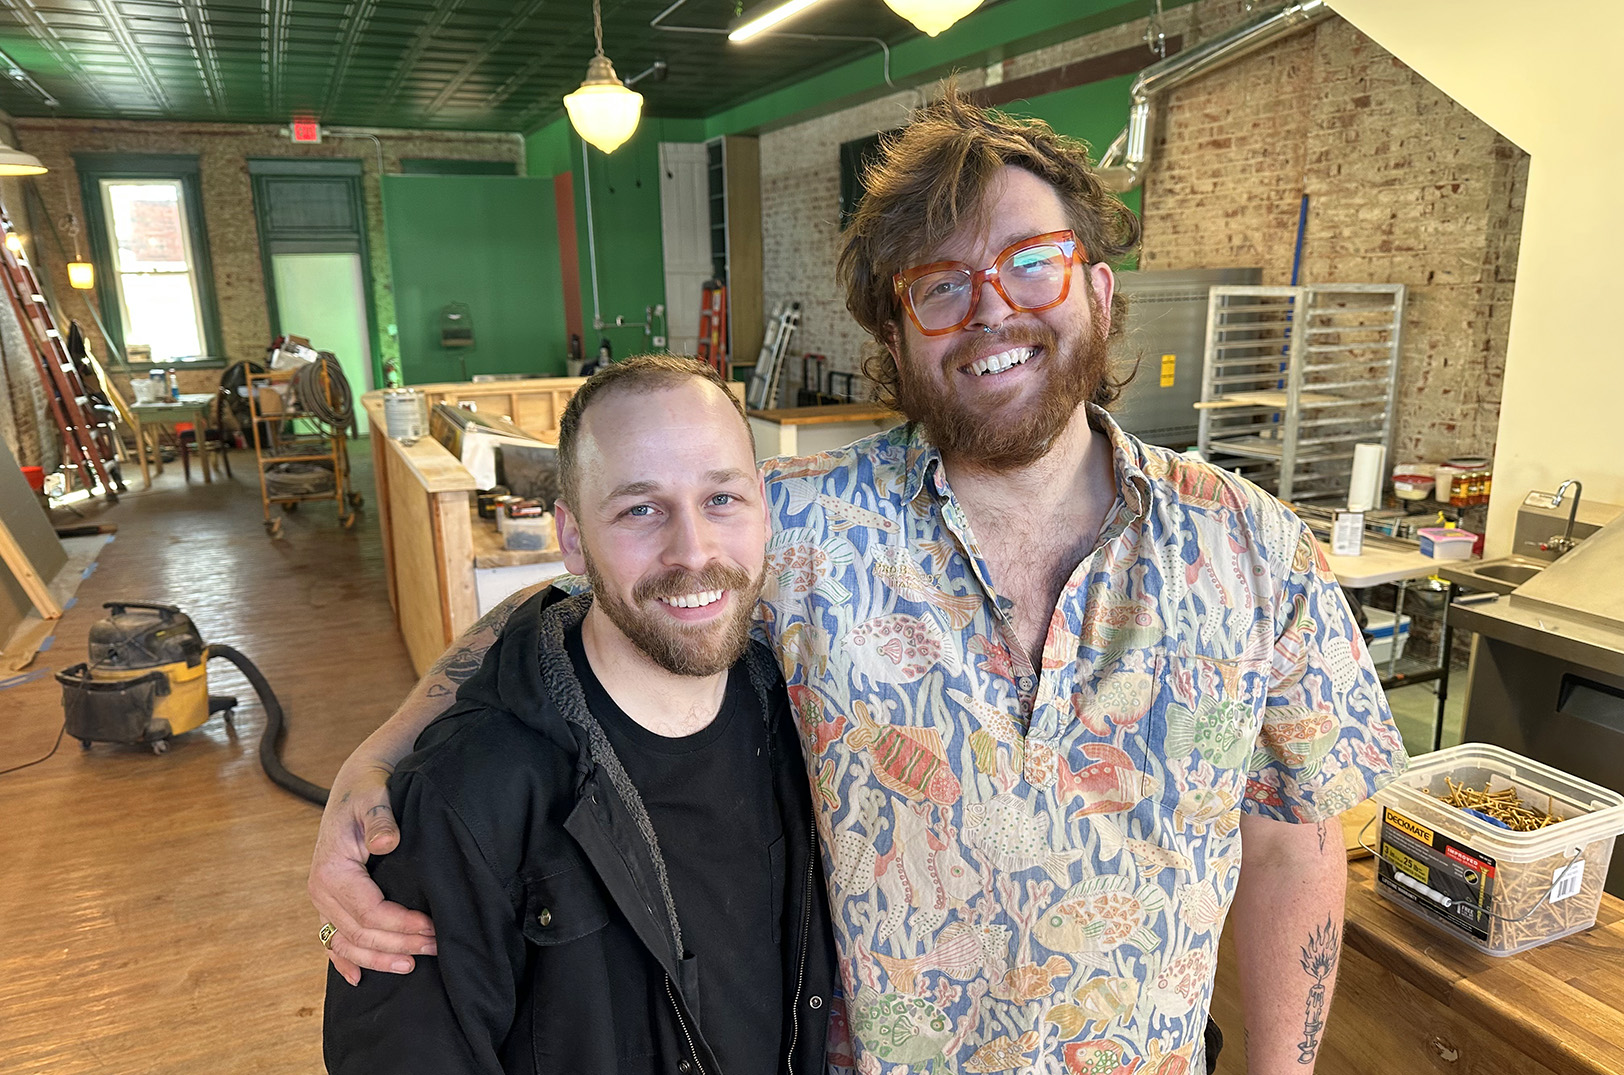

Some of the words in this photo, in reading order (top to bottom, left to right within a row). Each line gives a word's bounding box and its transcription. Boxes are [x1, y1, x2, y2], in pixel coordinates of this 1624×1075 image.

[1387, 812, 1431, 841] DECKMATE
[1384, 845, 1389, 854] 3
[1403, 857, 1413, 868] 25
[1447, 847, 1479, 866] IMPROVED
